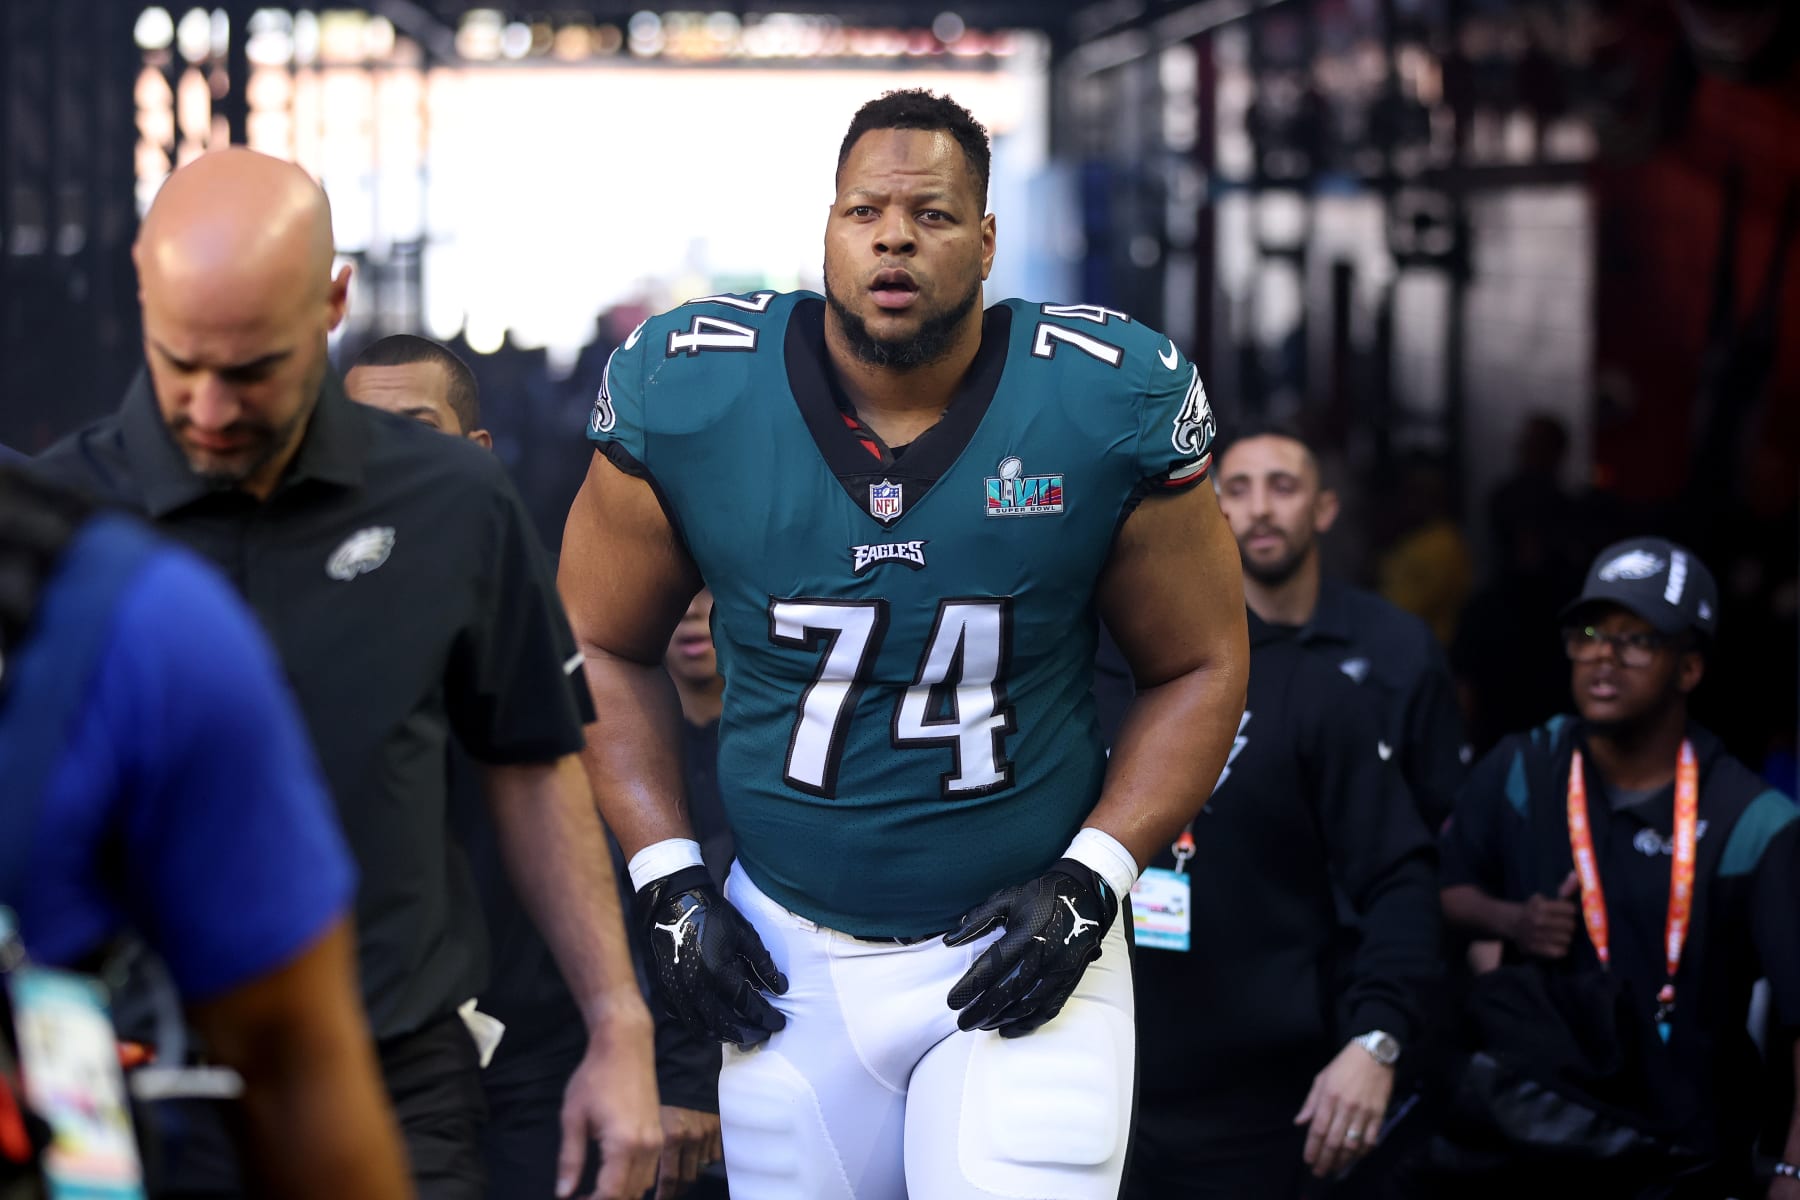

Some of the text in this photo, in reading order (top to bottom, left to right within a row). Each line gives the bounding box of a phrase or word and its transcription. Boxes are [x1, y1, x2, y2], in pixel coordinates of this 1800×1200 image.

[667, 291, 776, 357] 74
[1031, 303, 1130, 368] 74
[874, 498, 898, 514] NFL
[988, 478, 1062, 508] LVII
[851, 541, 926, 571] EAGLES
[769, 597, 1017, 799] 74
